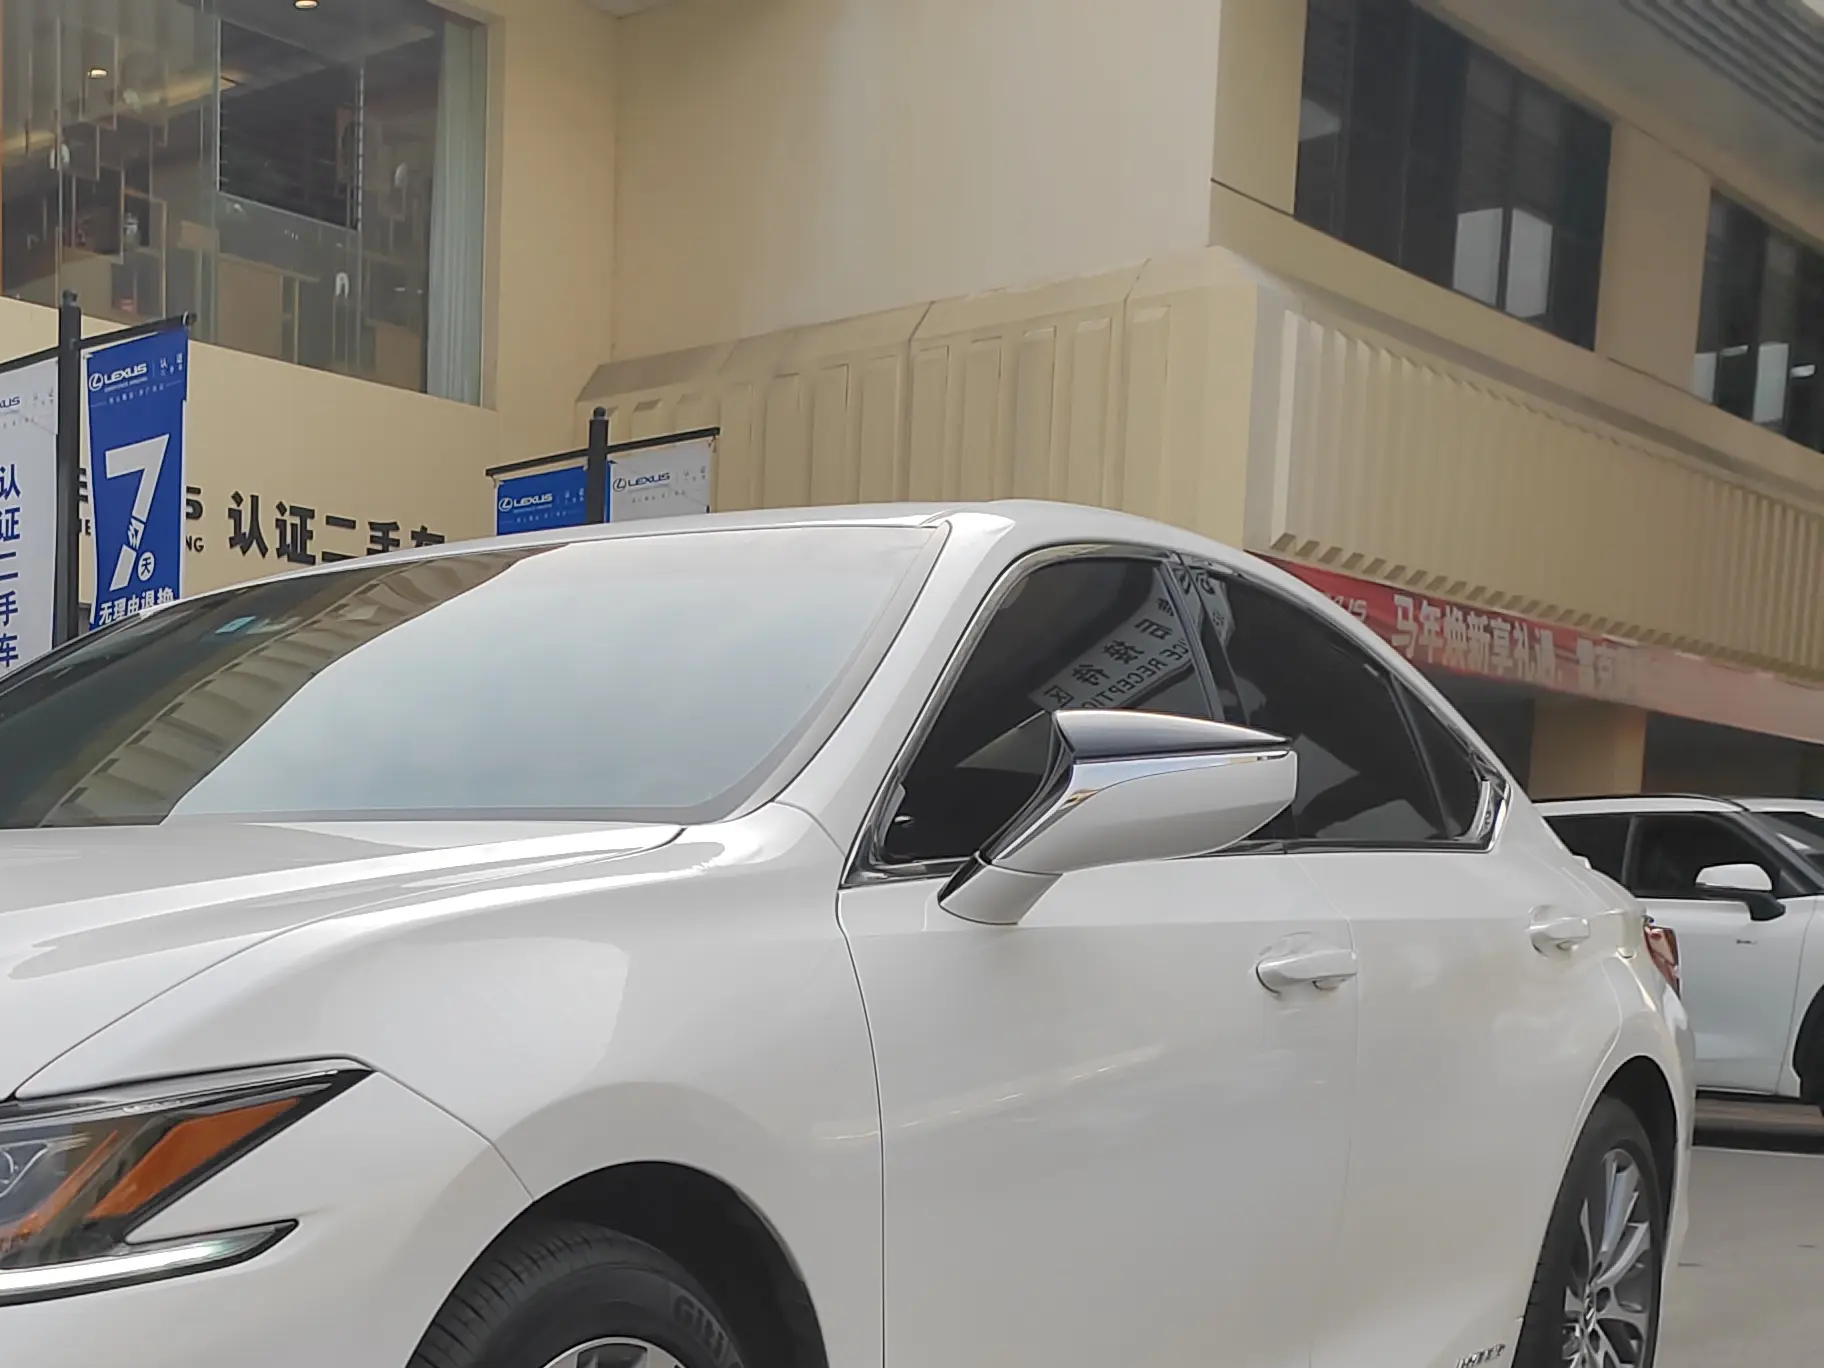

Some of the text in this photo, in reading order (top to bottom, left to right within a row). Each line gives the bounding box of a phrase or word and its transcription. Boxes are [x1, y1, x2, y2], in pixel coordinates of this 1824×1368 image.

[104, 363, 148, 384] LEXUS
[627, 472, 670, 487] LEXUS
[513, 492, 553, 508] LEXUS
[105, 432, 171, 592] 7
